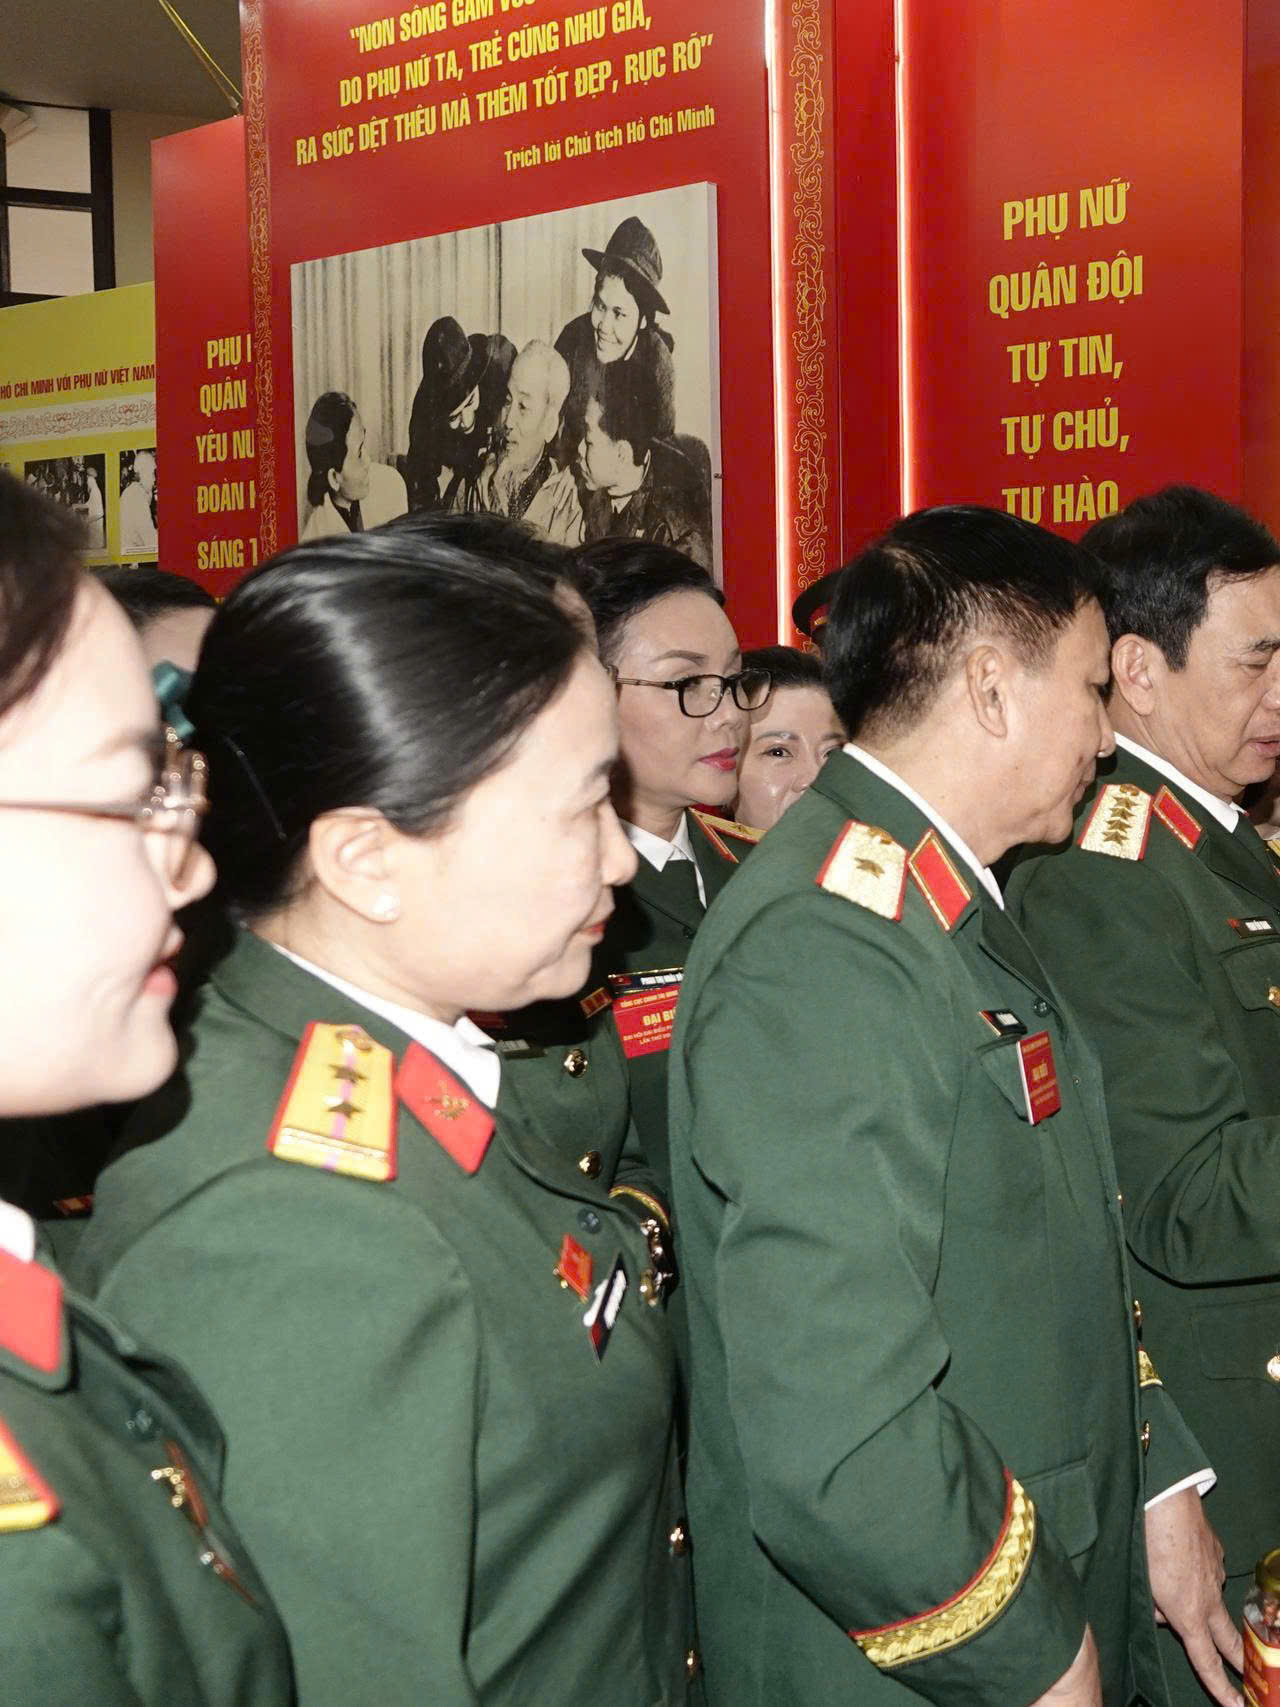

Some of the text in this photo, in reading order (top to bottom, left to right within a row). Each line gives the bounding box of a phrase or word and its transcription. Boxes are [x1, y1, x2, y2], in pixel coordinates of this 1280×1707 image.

[400, 2, 447, 42] SÔNG
[339, 76, 362, 107] DO
[366, 65, 401, 99] PHỤ
[405, 53, 431, 91] NỮ
[435, 50, 464, 81] TA,
[468, 29, 503, 72] TRẺ
[507, 21, 560, 62] CŨNG
[565, 6, 608, 48] NHƯ
[296, 136, 318, 166] RA
[322, 124, 354, 160] SỨC
[359, 115, 389, 153] DỆT
[394, 104, 437, 142] THÊU
[441, 92, 471, 131] MÀ
[476, 81, 528, 122] THÊM
[532, 65, 569, 108] TỐT
[505, 104, 715, 171] Trích lời Chủ tịch Hồ Chí Minh
[1003, 177, 1130, 240] PHỤ NỮ
[989, 250, 1143, 318] QUÂN ĐỘI
[207, 336, 241, 370] PHỤ
[1007, 334, 1123, 387] TỰ TIN,
[31, 378, 54, 395] MINH
[74, 373, 91, 391] PHỤ
[110, 366, 129, 386] VIỆT
[133, 364, 155, 381] NAM
[200, 376, 246, 417] QUÂN
[196, 428, 227, 464] YÊU
[1001, 397, 1129, 460] TỰ CHỦ,
[197, 478, 244, 514] ĐOÀN
[197, 535, 244, 570] SÁNG
